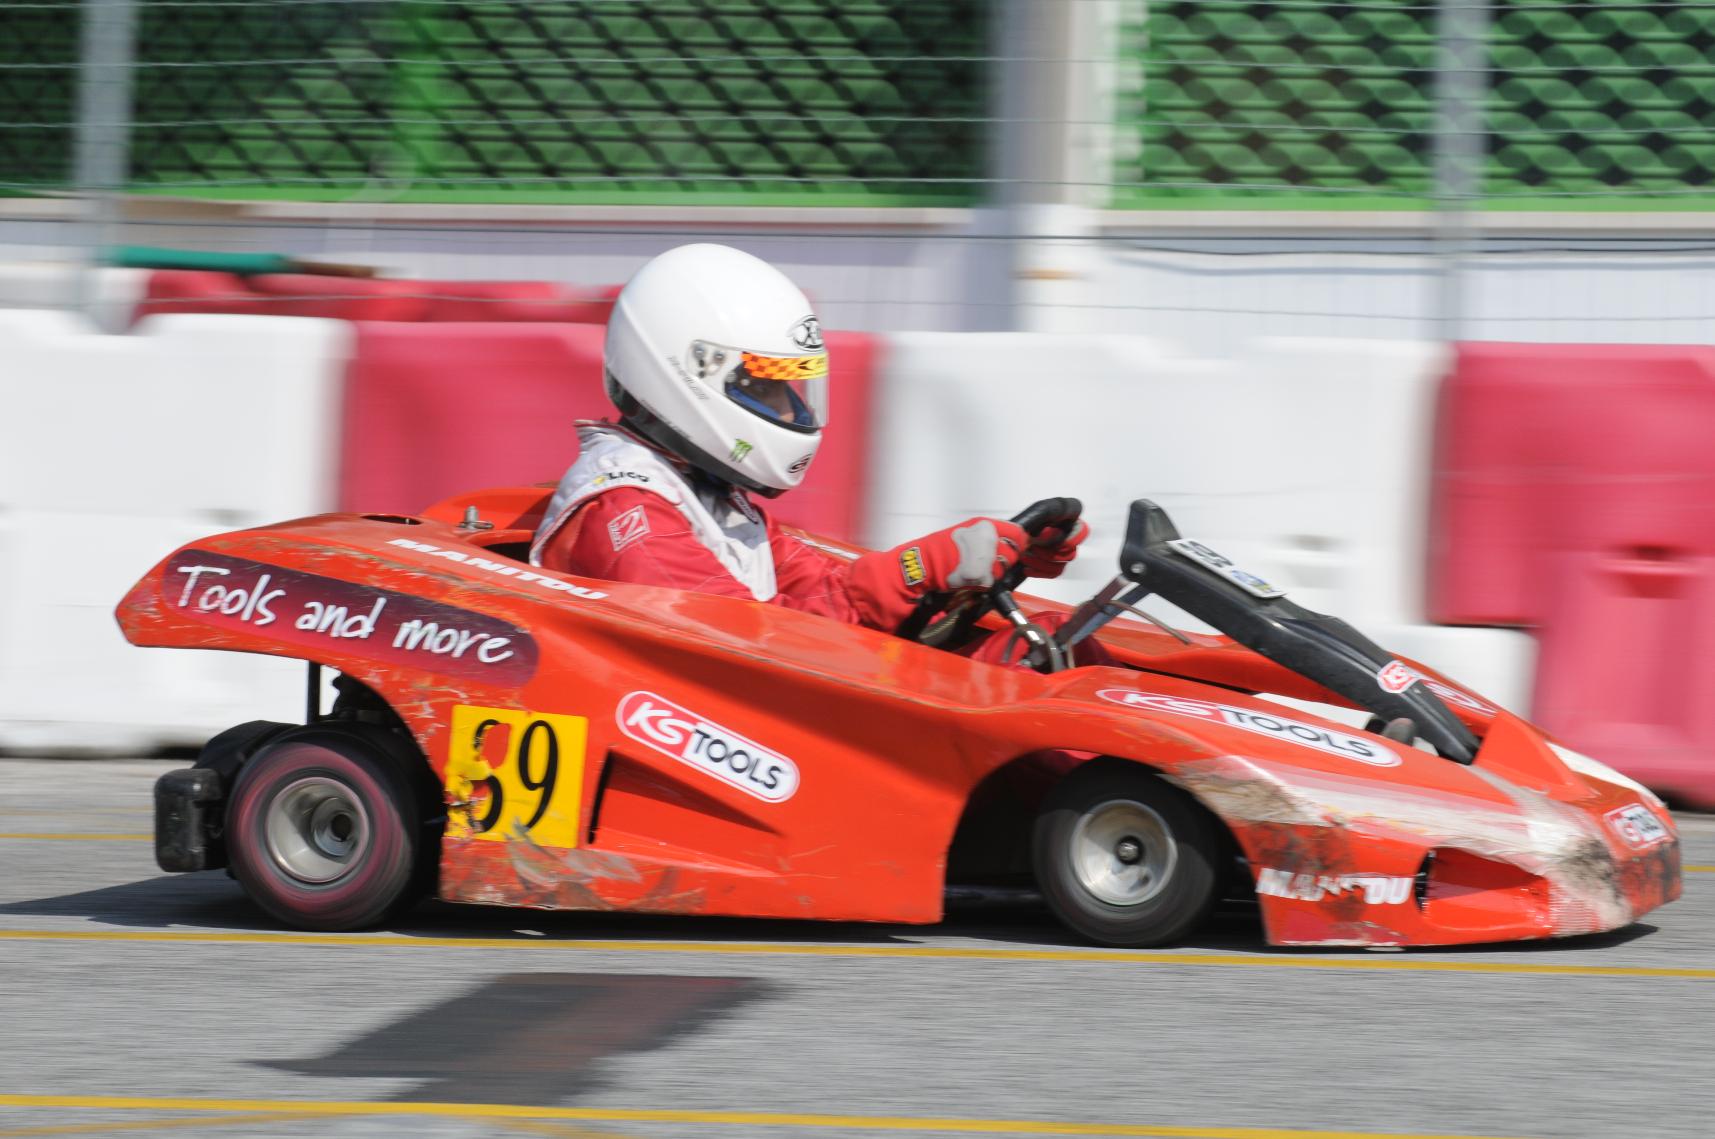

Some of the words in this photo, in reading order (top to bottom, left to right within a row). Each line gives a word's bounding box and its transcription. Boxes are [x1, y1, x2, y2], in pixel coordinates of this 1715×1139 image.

[385, 538, 609, 600] MANITOU
[177, 566, 286, 625] Tools
[295, 597, 387, 639] and
[392, 620, 514, 663] more
[626, 702, 697, 745] KS
[694, 728, 785, 790] TOOLS
[1122, 693, 1218, 716] KS
[1217, 707, 1376, 757] TOOLS
